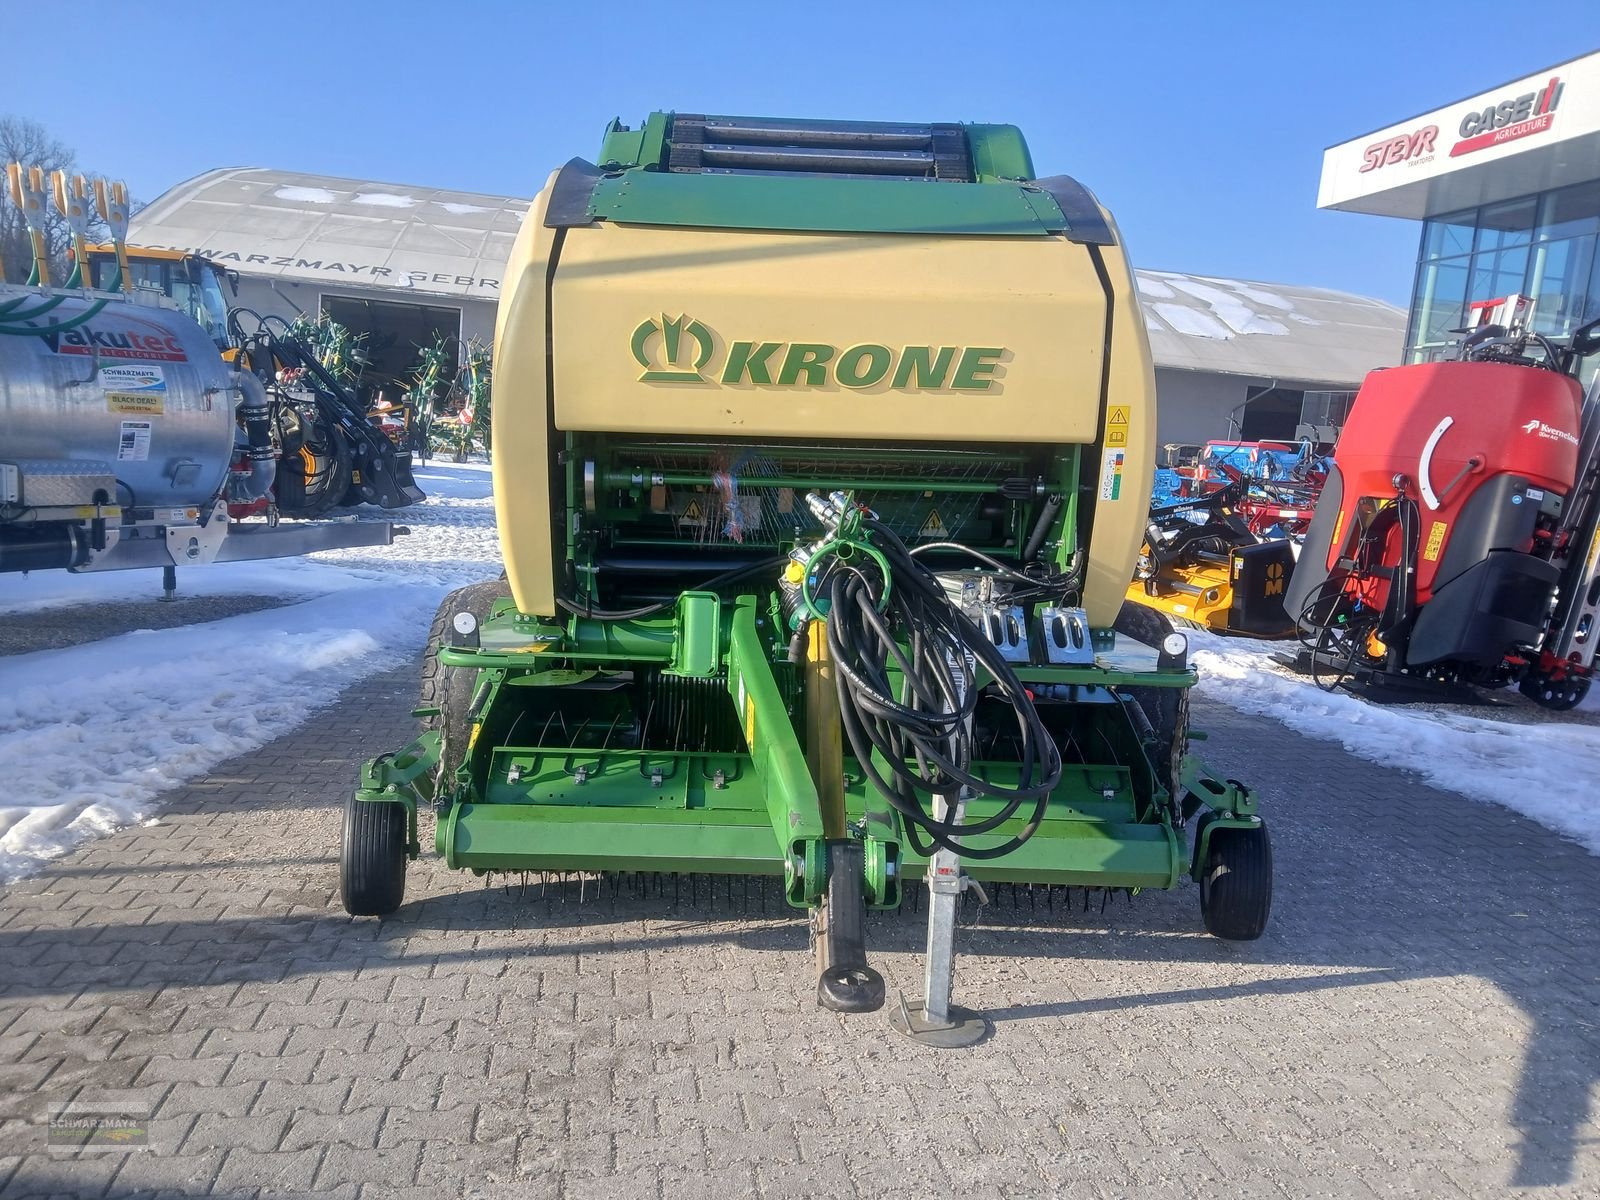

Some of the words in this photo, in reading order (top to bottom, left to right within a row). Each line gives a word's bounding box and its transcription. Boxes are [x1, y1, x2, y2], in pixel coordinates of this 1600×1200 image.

[1459, 92, 1537, 138] CASE
[1495, 117, 1547, 141] AGRICULTURE
[1359, 126, 1439, 173] STEYR
[113, 242, 393, 277] WARZMAYR
[24, 316, 185, 354] Vakutec
[102, 369, 155, 377] SCHWARZMAYR
[720, 340, 1005, 391] KRONE
[112, 396, 136, 404] BLACK
